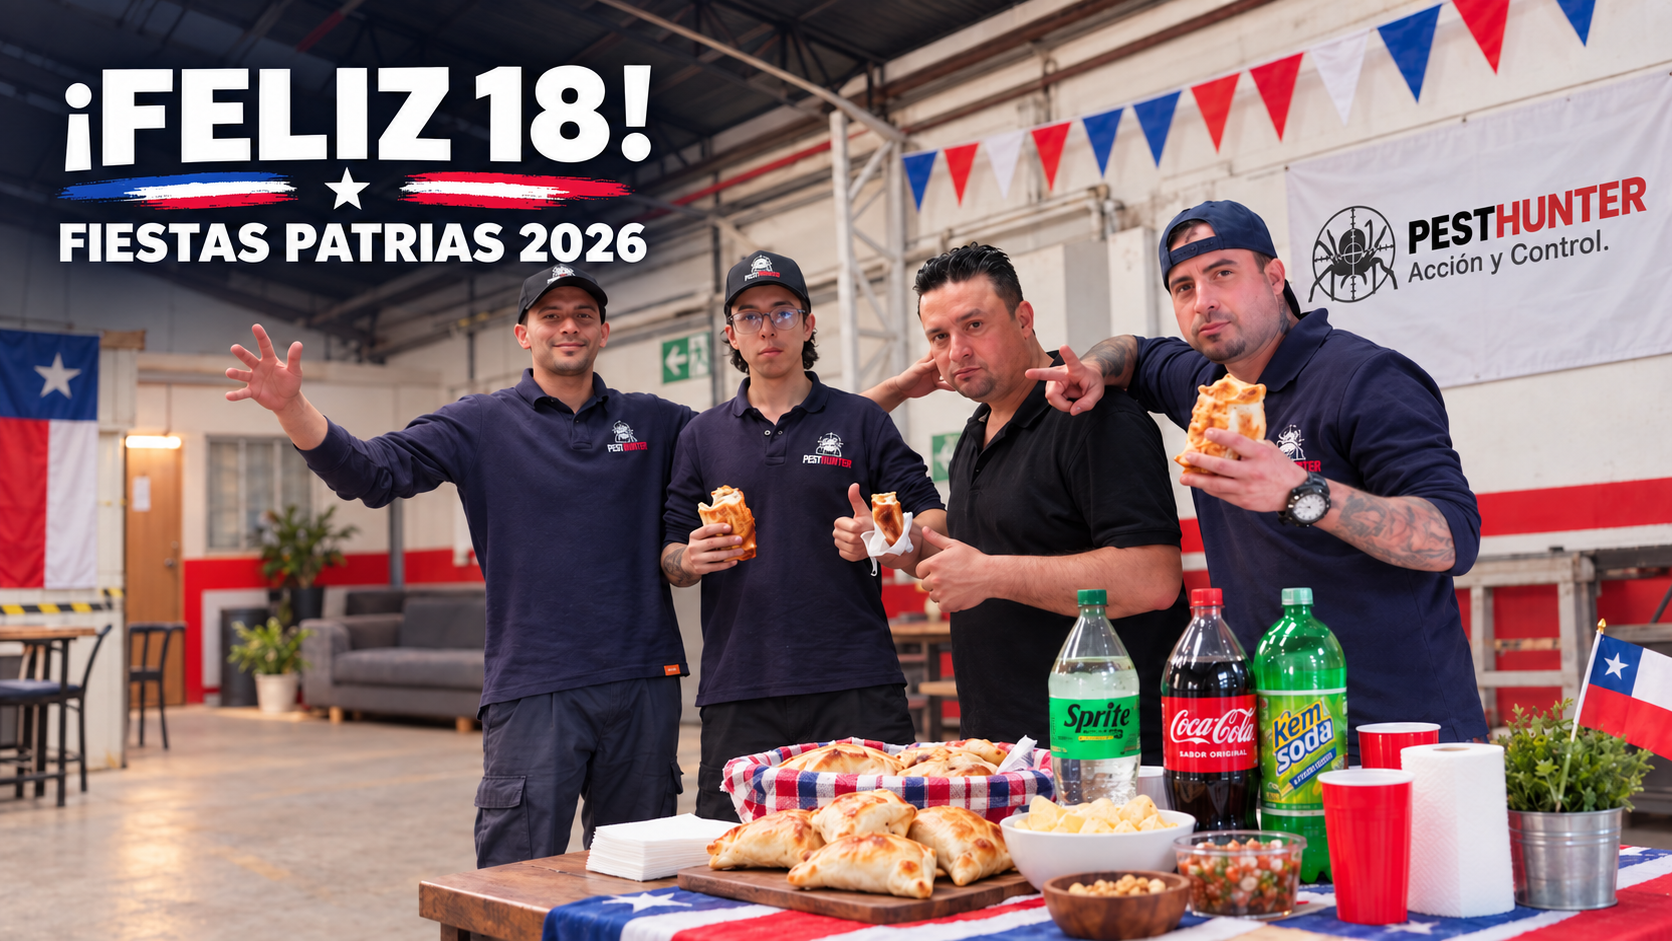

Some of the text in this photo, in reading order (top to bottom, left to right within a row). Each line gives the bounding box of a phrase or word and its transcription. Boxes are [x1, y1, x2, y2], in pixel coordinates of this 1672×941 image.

[1408, 176, 1647, 255] PESTHUNTER
[1408, 229, 1609, 283] Acción y Control.
[1064, 702, 1130, 734] Sprite
[1170, 707, 1255, 745] Coca-Cola
[1179, 749, 1248, 758] SABOR ORIGINAL
